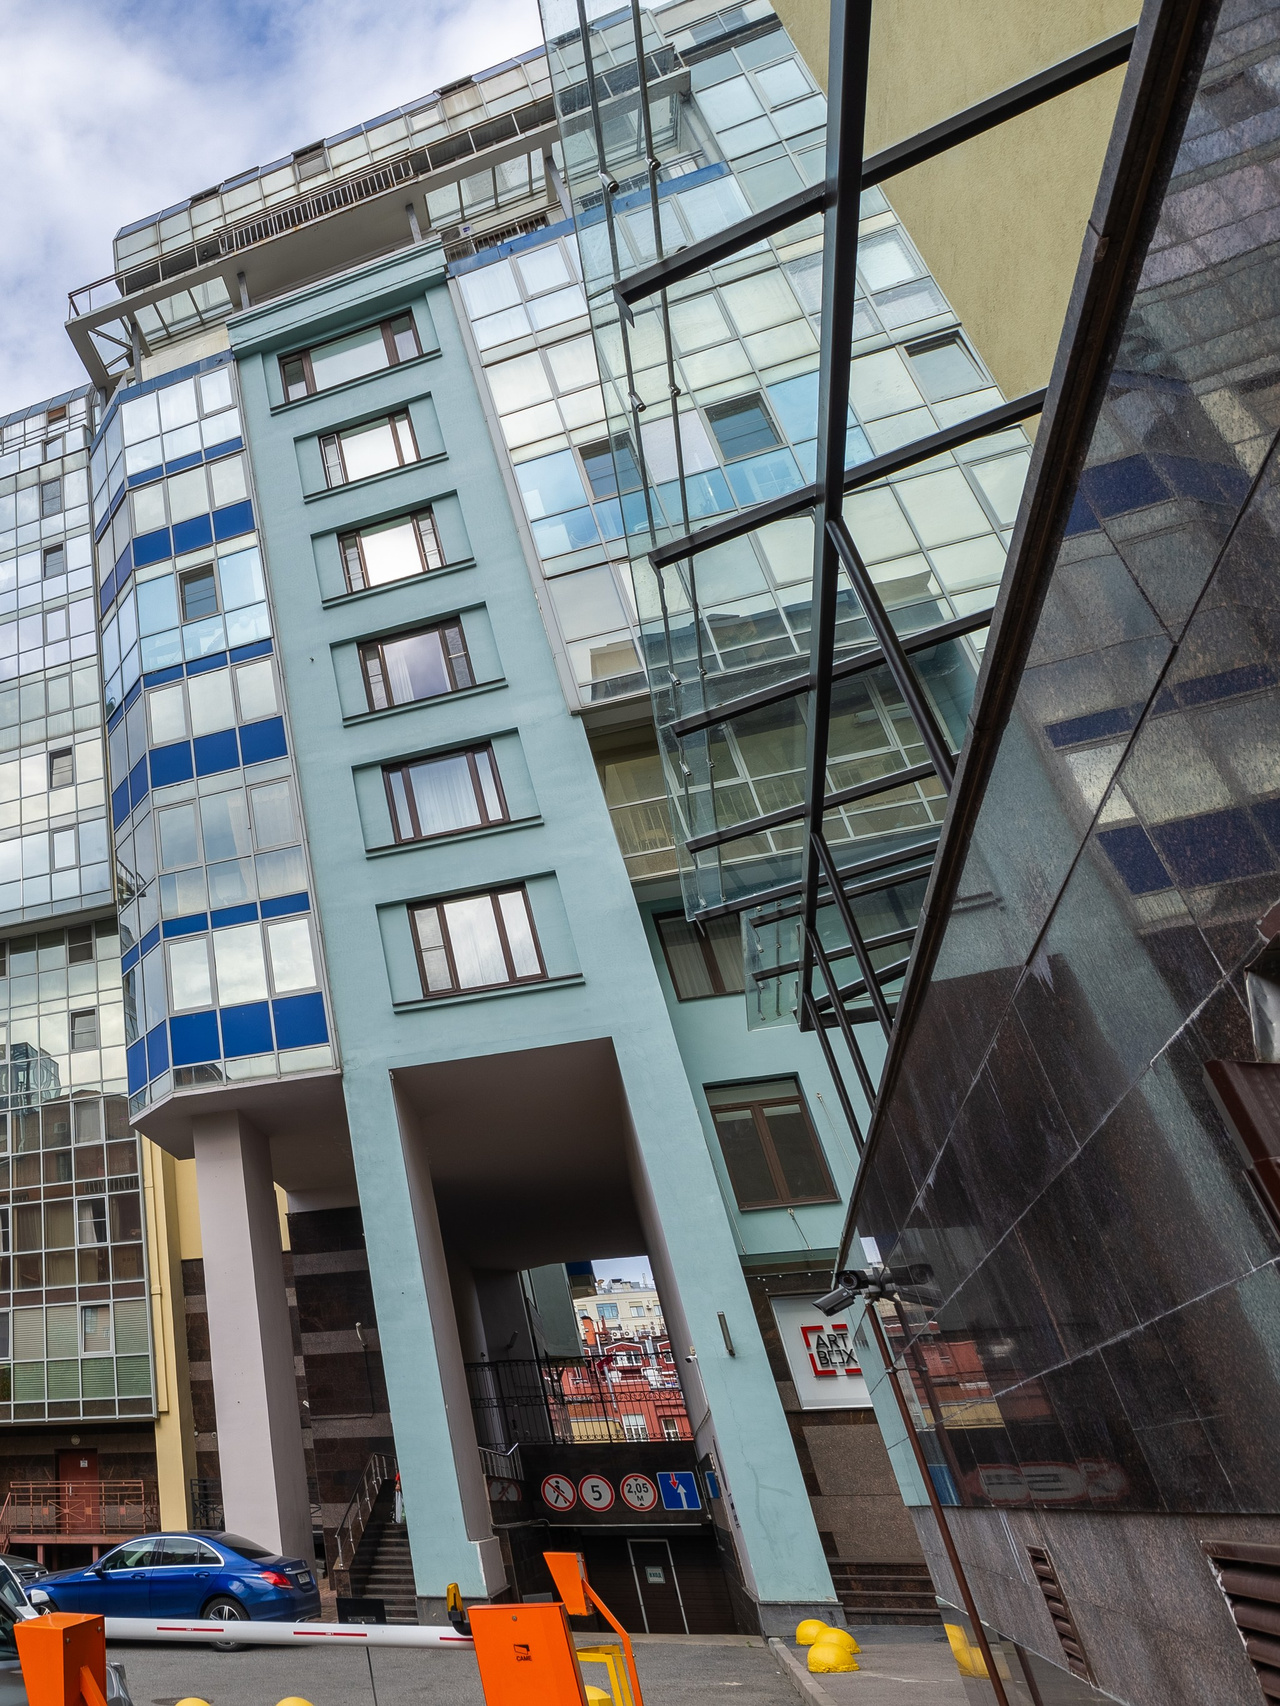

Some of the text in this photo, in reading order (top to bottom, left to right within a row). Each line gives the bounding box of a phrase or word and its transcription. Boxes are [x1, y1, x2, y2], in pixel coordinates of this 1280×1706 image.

[816, 1333, 848, 1349] ART
[591, 1485, 602, 1501] 5
[626, 1483, 648, 1495] 2,05
